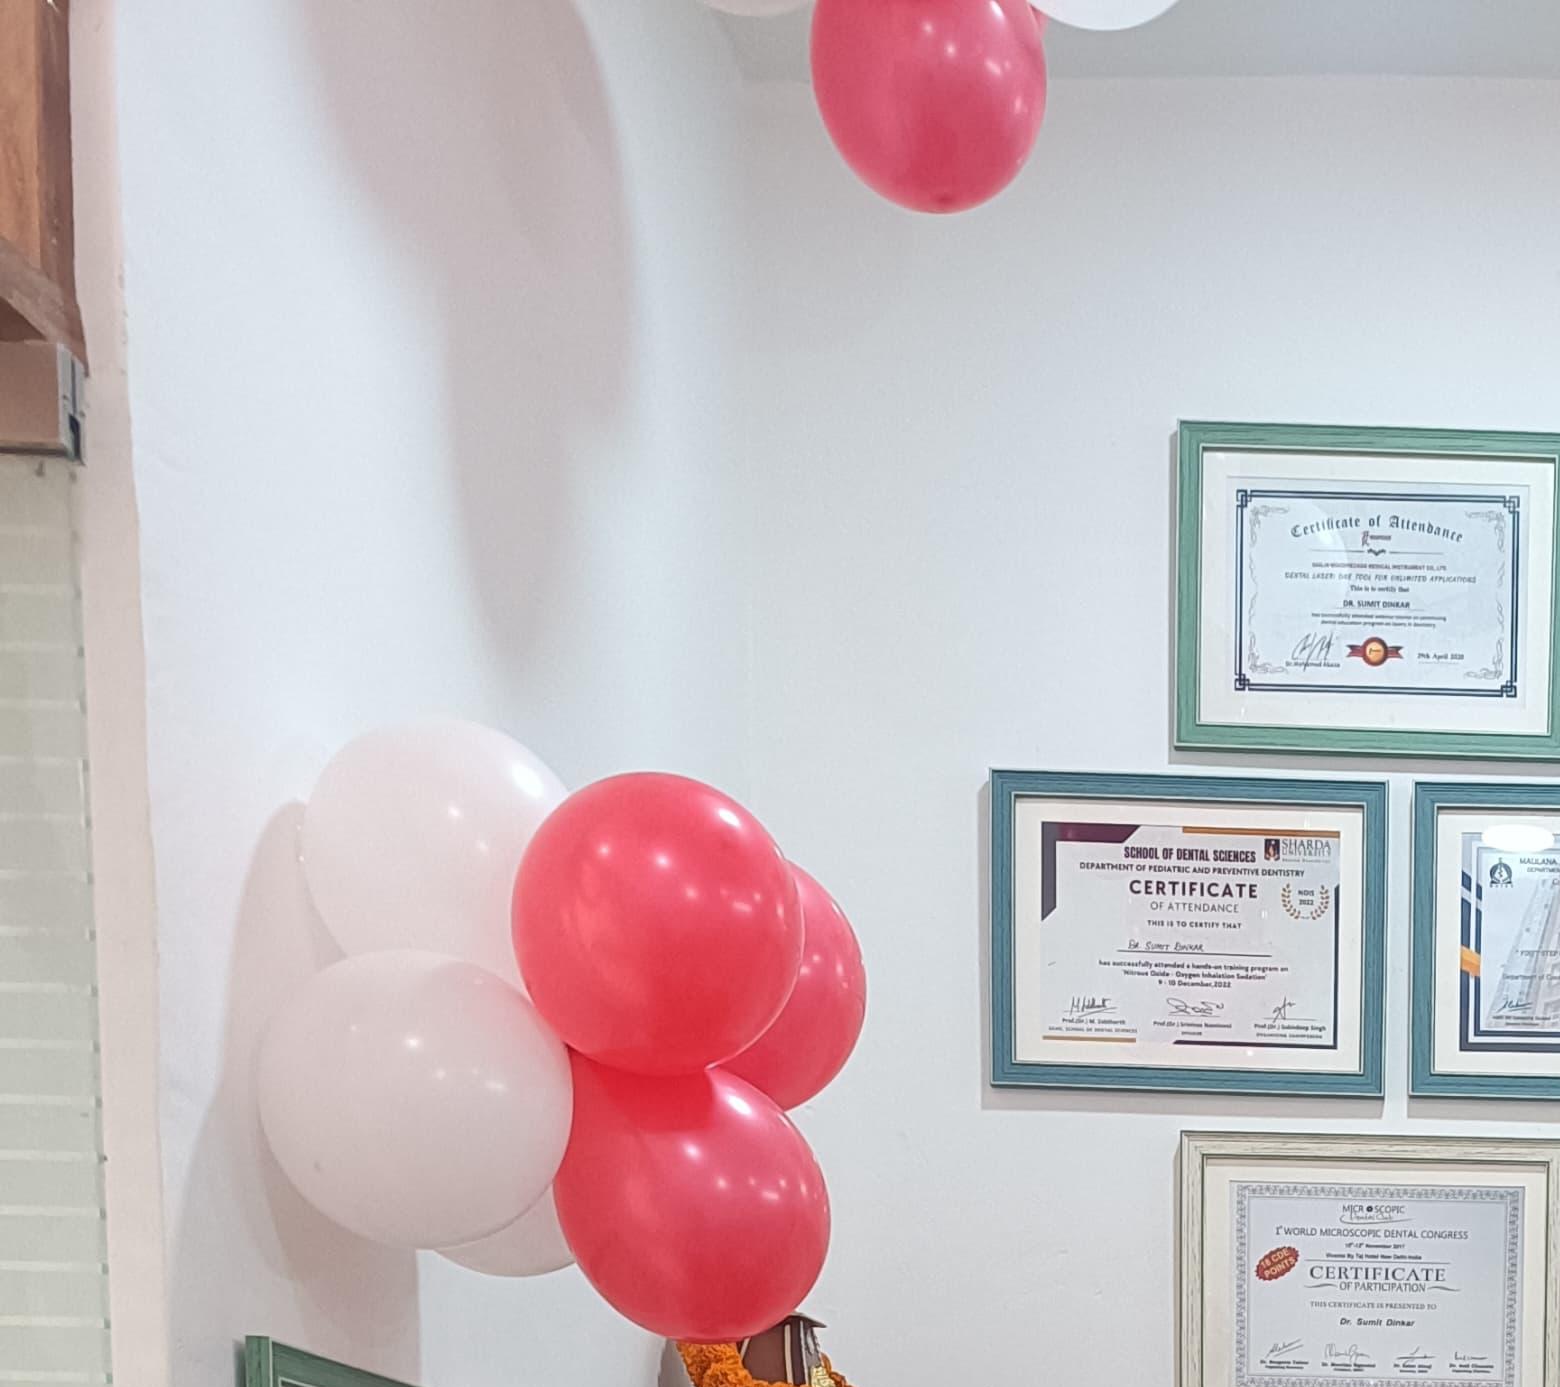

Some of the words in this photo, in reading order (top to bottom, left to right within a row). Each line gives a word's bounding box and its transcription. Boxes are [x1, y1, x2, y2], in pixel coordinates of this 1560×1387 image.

[1291, 516, 1360, 537] Certificate
[1369, 515, 1380, 527] of
[1389, 515, 1463, 542] Attendance
[1281, 838, 1331, 850] SHARDA
[1124, 847, 1160, 859] SCHOOL
[1163, 848, 1173, 860] OF
[1176, 848, 1210, 862] DENTAL
[1213, 849, 1256, 863] SCIENCES
[1079, 862, 1134, 872] DEPARTMENT
[1136, 864, 1146, 872] OF
[1148, 864, 1190, 873] PEDIATRIC
[1192, 866, 1210, 874] AND
[1212, 866, 1259, 875] PREVENTIVE
[1261, 868, 1305, 877] DENTISTRY
[1129, 880, 1258, 899] CERTIFICATE
[1150, 901, 1165, 911] OF
[1167, 902, 1239, 914] ATTENDANCE
[1147, 920, 1164, 928] THIS
[1189, 921, 1220, 929] CERTIFY
[1222, 922, 1242, 930] THAT
[1284, 1227, 1317, 1236] WORLD
[1320, 1228, 1381, 1238] MICROSCOPIC
[1384, 1229, 1418, 1239] DENTAL
[1421, 1230, 1468, 1239] CONGRESS
[1310, 1265, 1446, 1282] CERTIFICATE
[1339, 1281, 1353, 1291] OF
[1354, 1282, 1426, 1293] PARTICIPATION
[1357, 1318, 1383, 1327] Sumit
[1386, 1318, 1415, 1327] Dinkar
